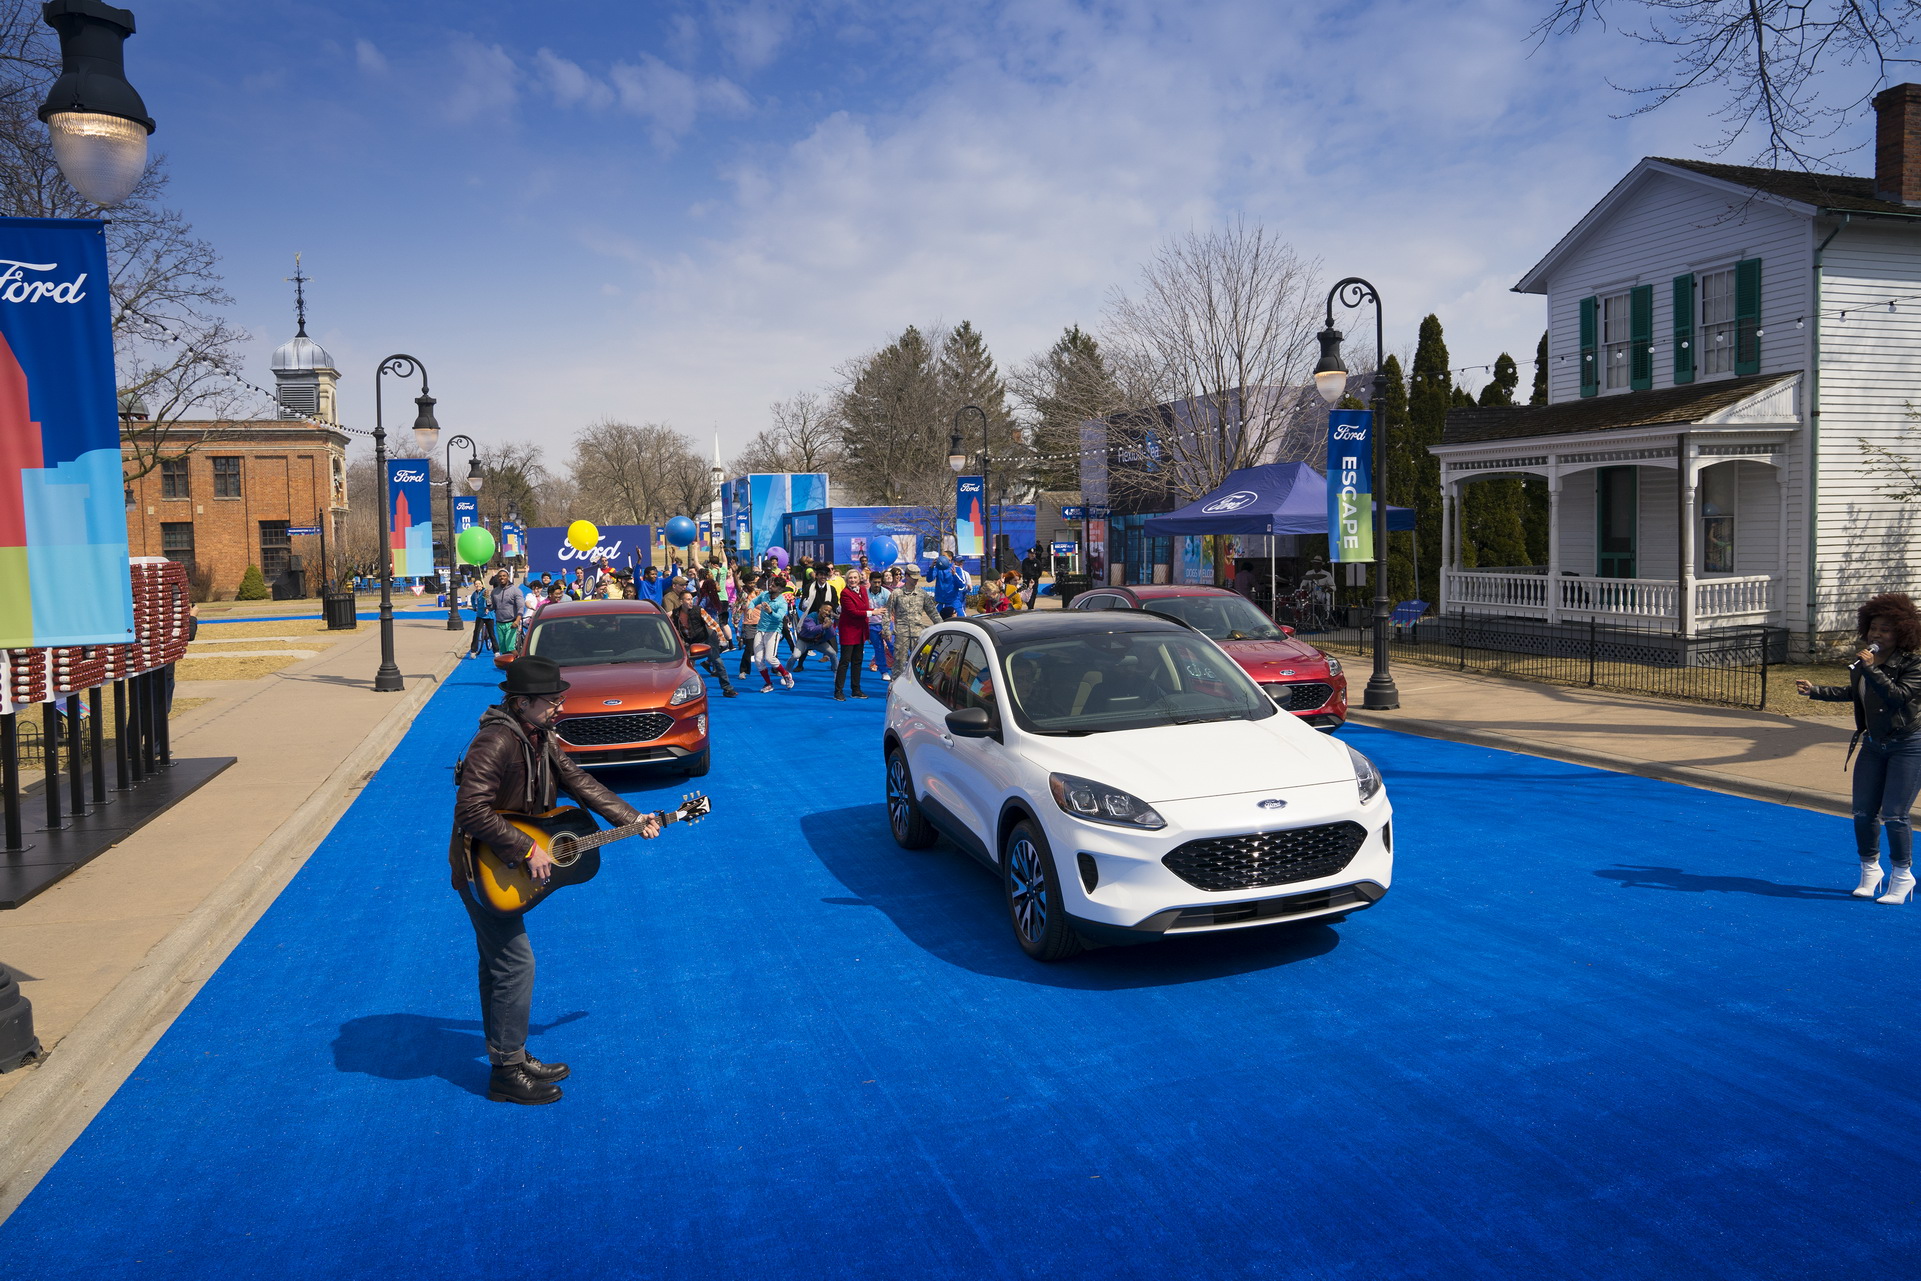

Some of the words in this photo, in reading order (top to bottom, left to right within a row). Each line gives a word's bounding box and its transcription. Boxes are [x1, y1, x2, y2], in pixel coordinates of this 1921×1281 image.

[1333, 424, 1367, 441] Ford
[393, 469, 425, 483] Ford
[960, 482, 981, 492] Ford
[456, 502, 475, 511] Ford
[1207, 494, 1250, 511] Ford
[1341, 456, 1359, 549] ESCAPE
